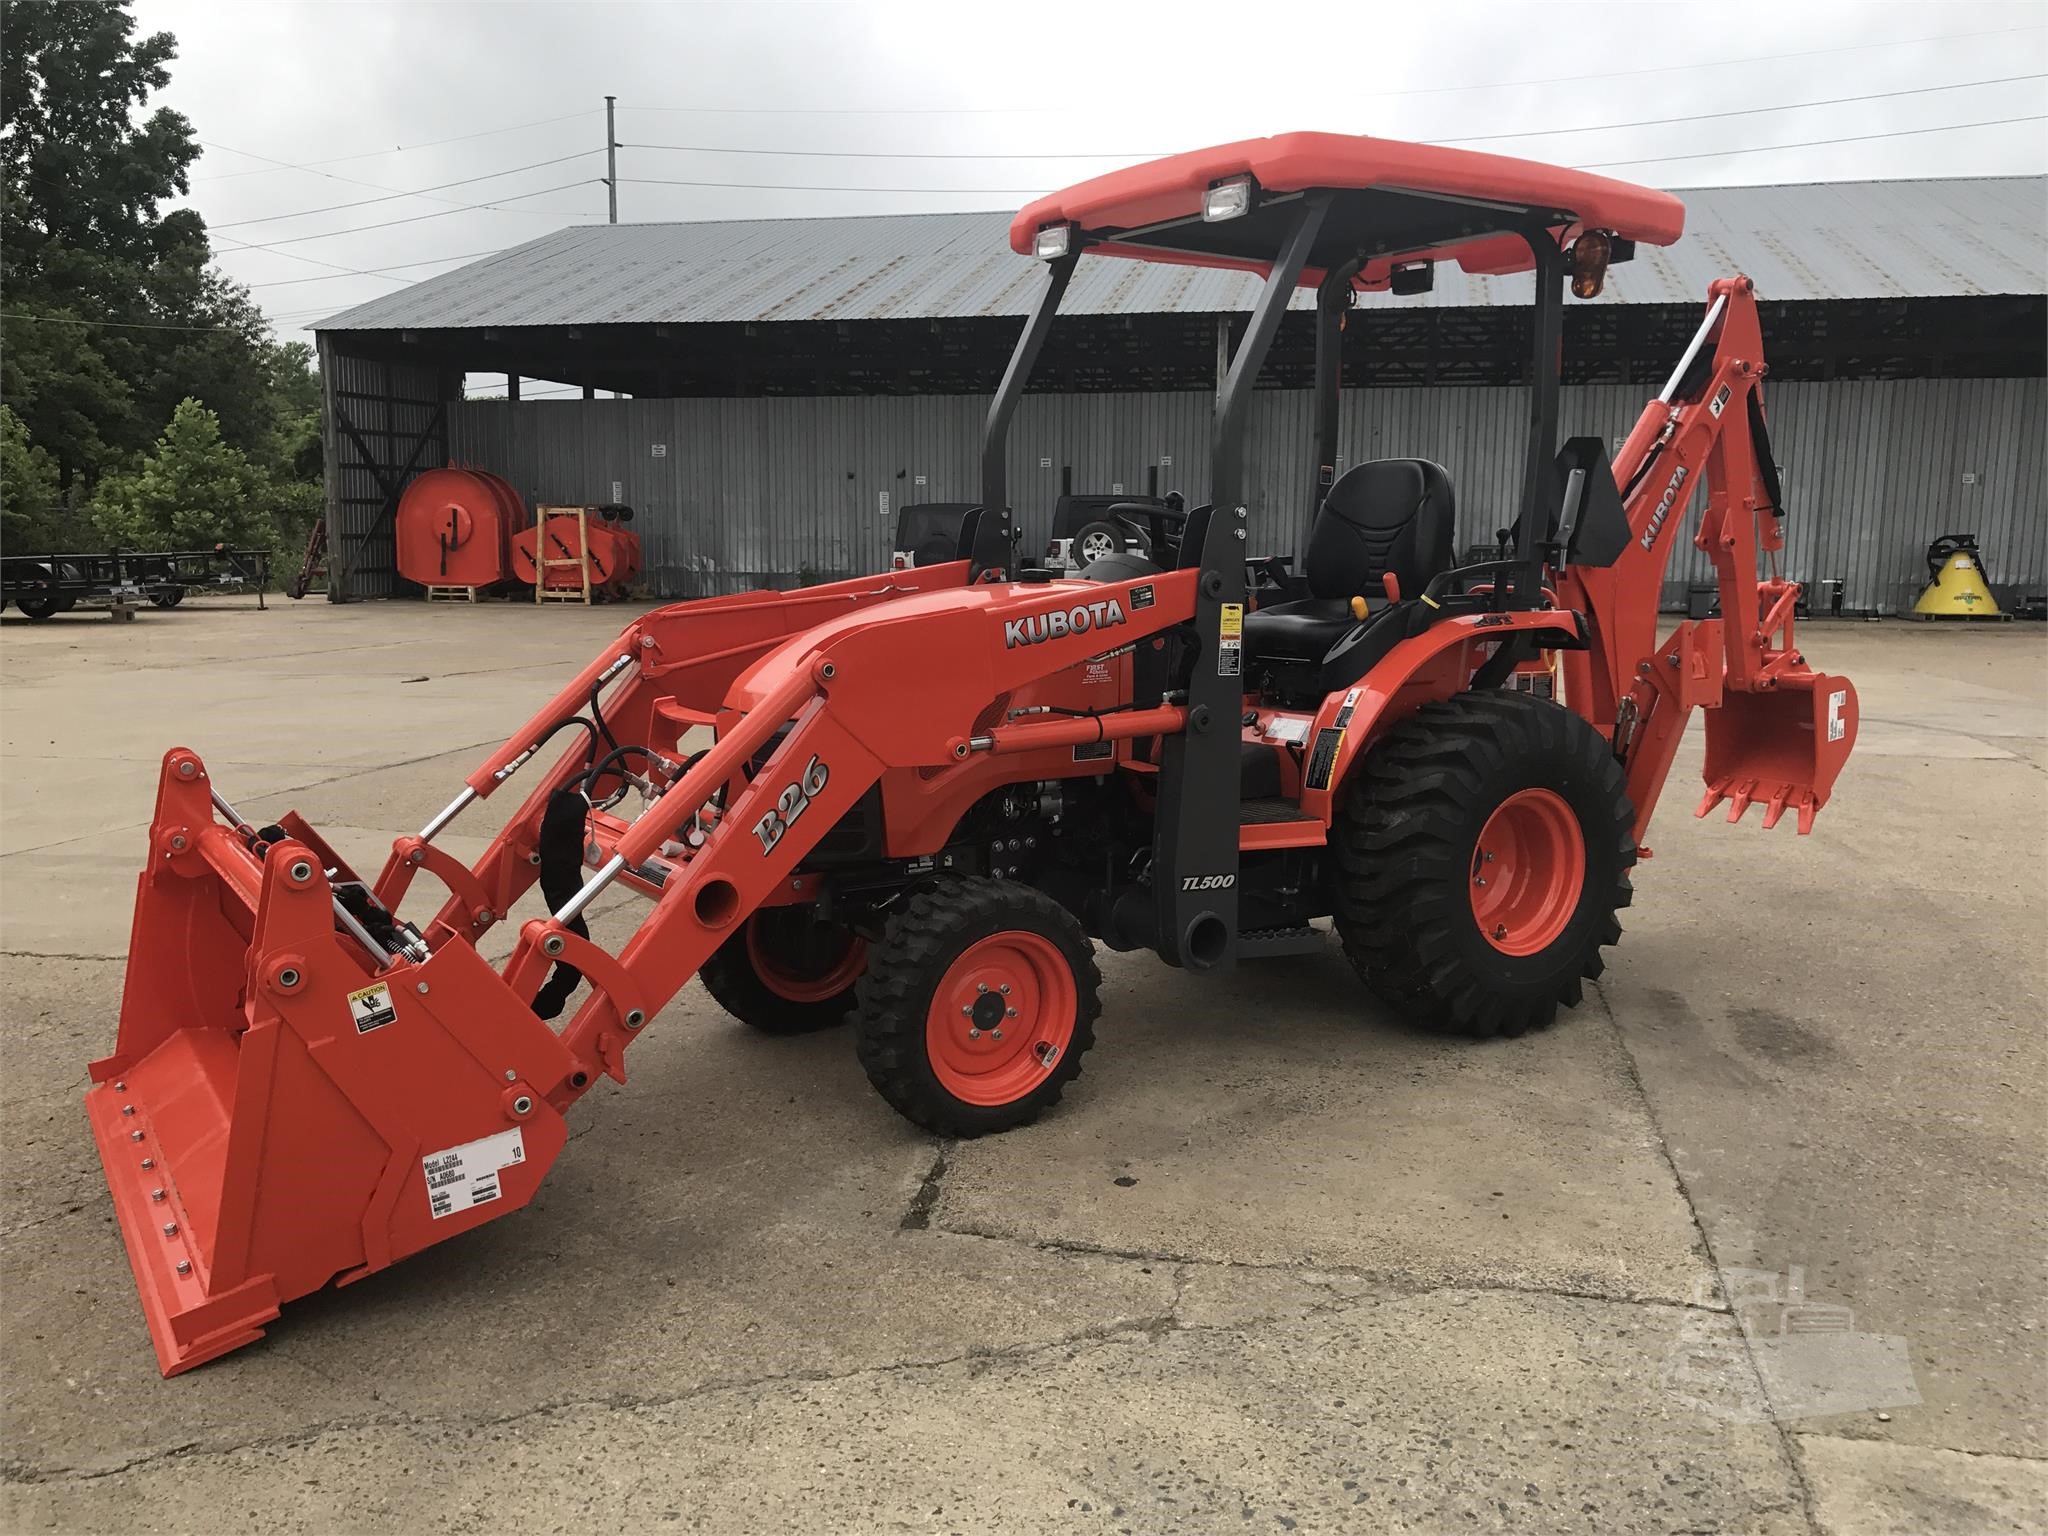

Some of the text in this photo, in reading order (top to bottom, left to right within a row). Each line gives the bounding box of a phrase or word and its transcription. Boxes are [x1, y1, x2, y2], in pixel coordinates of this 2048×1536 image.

[1640, 464, 1690, 553] KUBOTA
[1004, 599, 1127, 650] KUBOTA
[751, 752, 830, 858] B26
[1182, 874, 1236, 891] TL500
[357, 985, 385, 999] CAUTION
[424, 1153, 458, 1170] Model L2244
